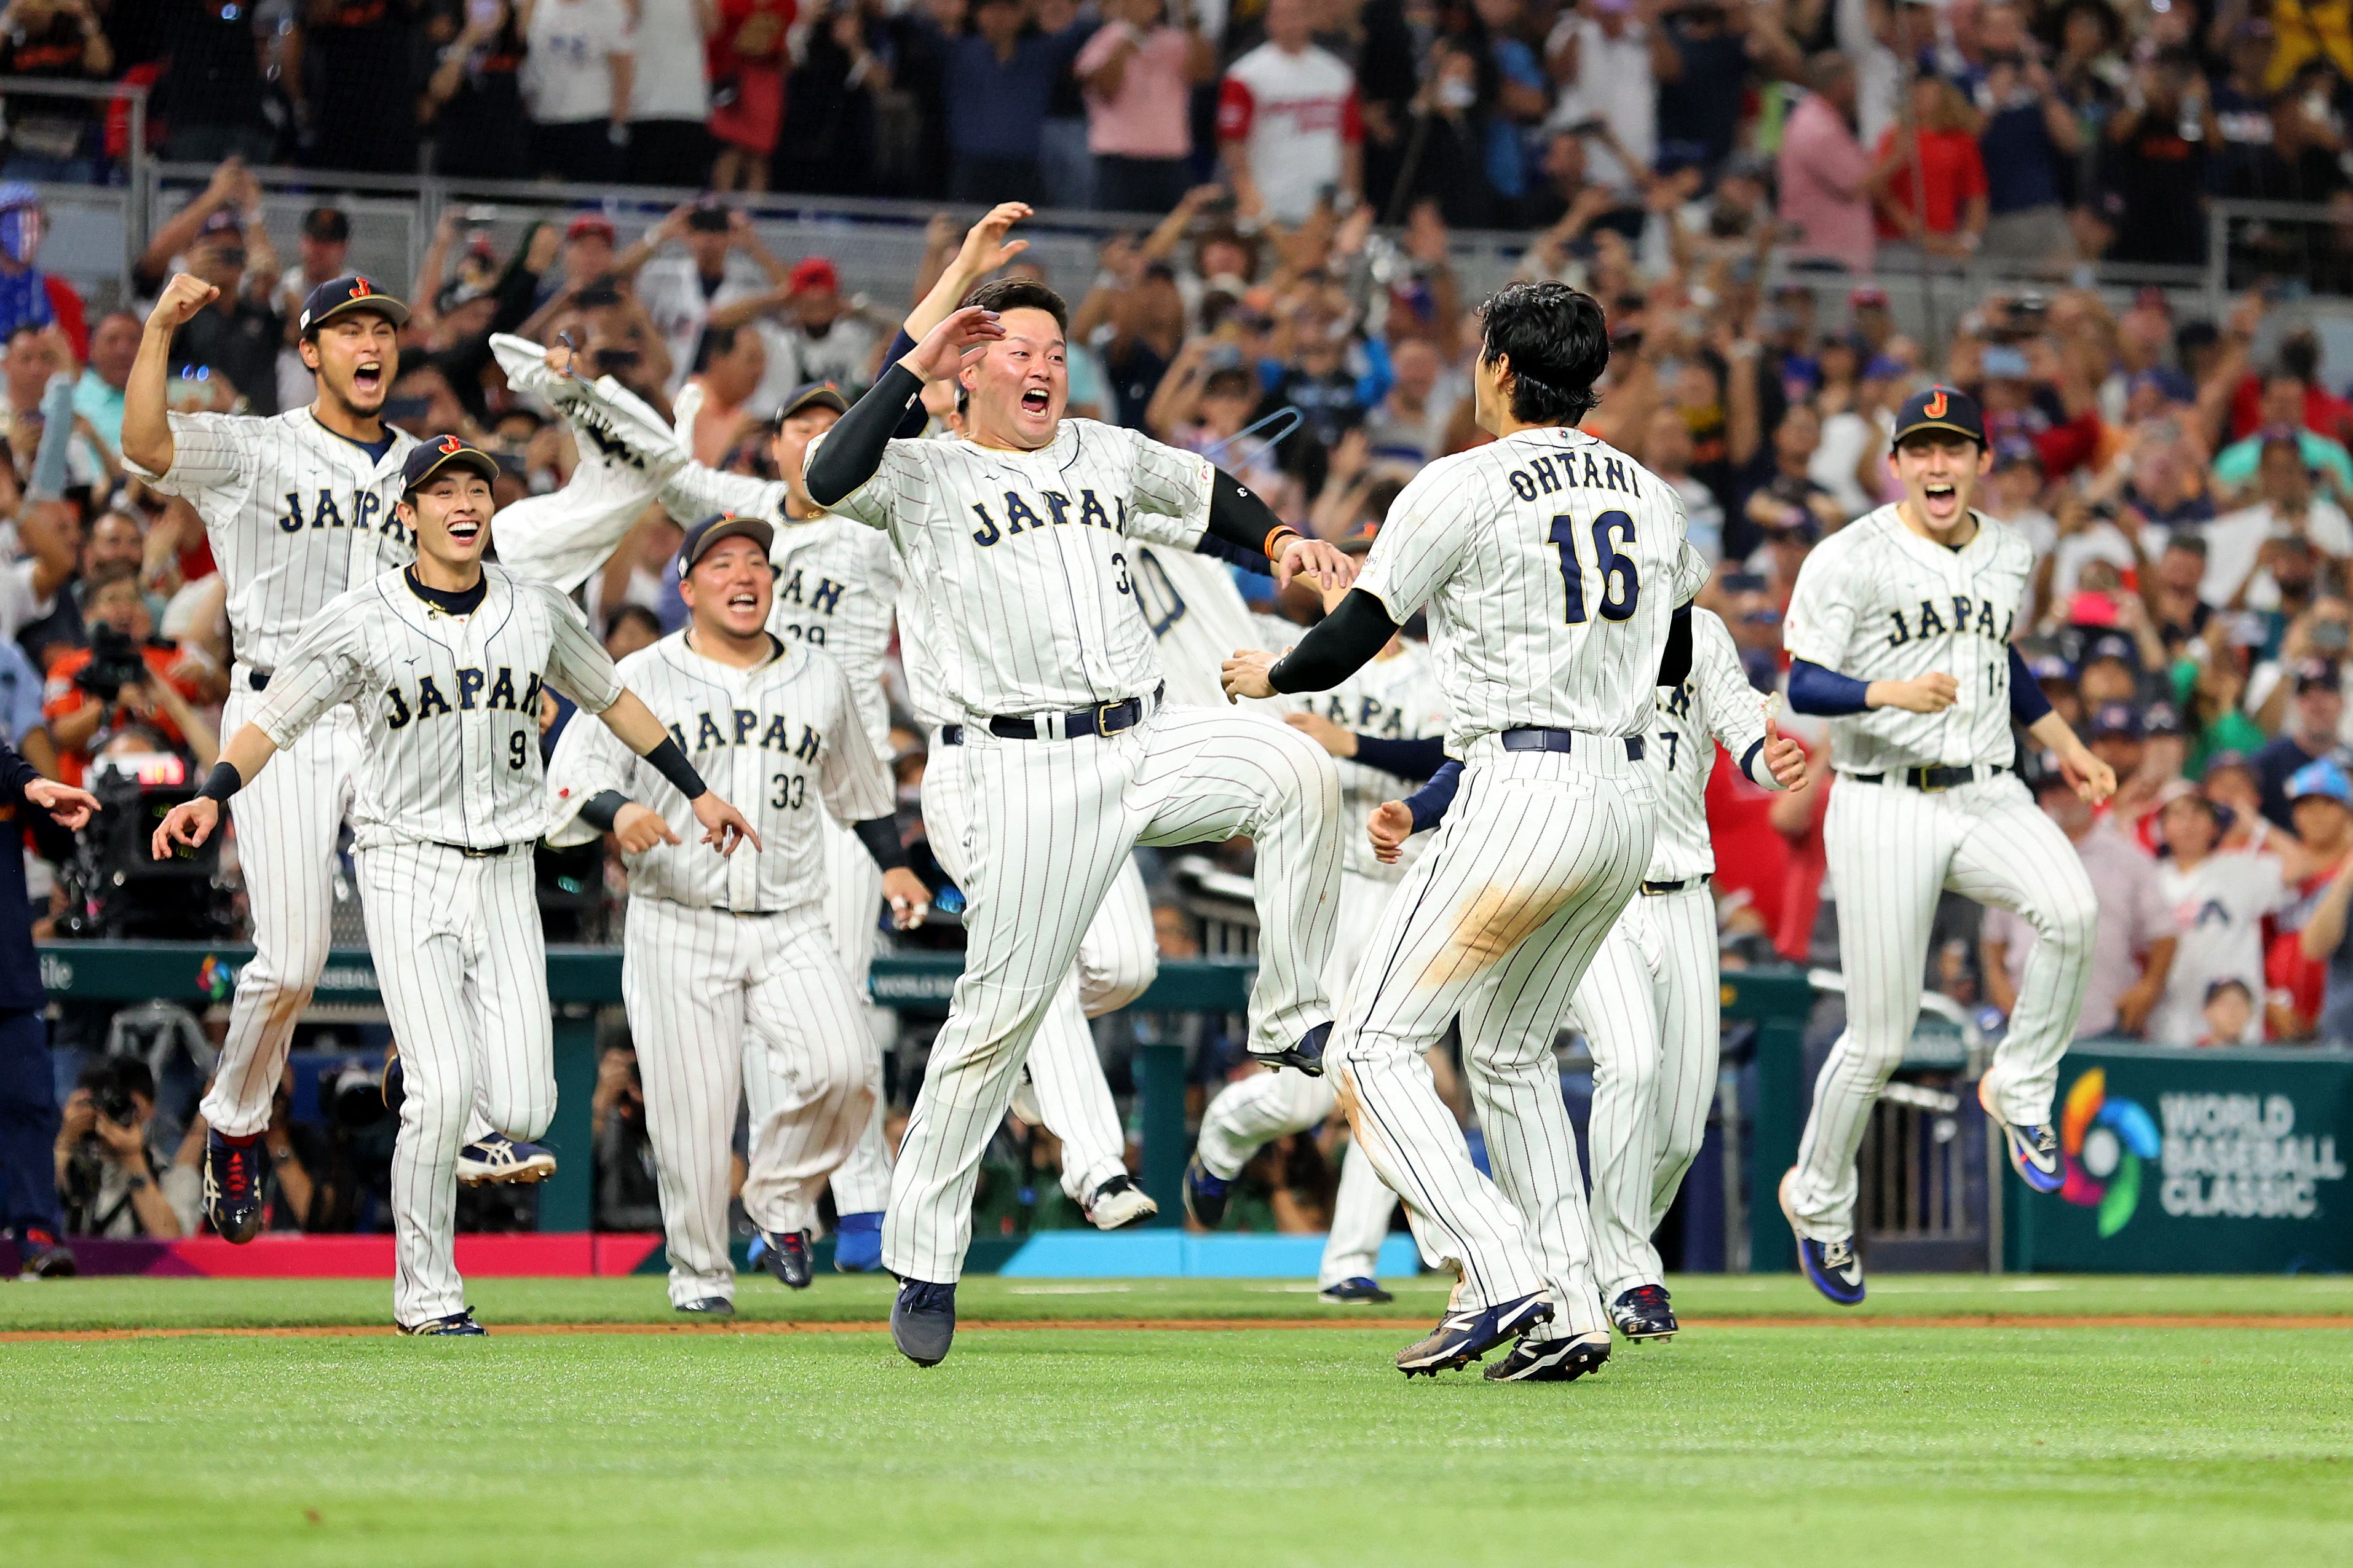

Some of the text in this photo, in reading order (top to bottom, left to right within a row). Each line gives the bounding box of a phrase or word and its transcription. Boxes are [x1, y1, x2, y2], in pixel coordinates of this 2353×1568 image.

[1923, 390, 1948, 418] J
[1509, 451, 1642, 503] OHTANI
[279, 487, 418, 548] JAPA
[1111, 552, 1131, 596] 3
[1546, 508, 1643, 626] 16
[386, 666, 544, 730] JAPAN
[510, 730, 526, 770] 9
[1659, 731, 1679, 771] 7
[771, 773, 804, 811] 33
[2159, 1093, 2295, 1137] WORLD
[2161, 1136, 2346, 1180] BASEBALL
[2159, 1176, 2316, 1218] CLASSIC
